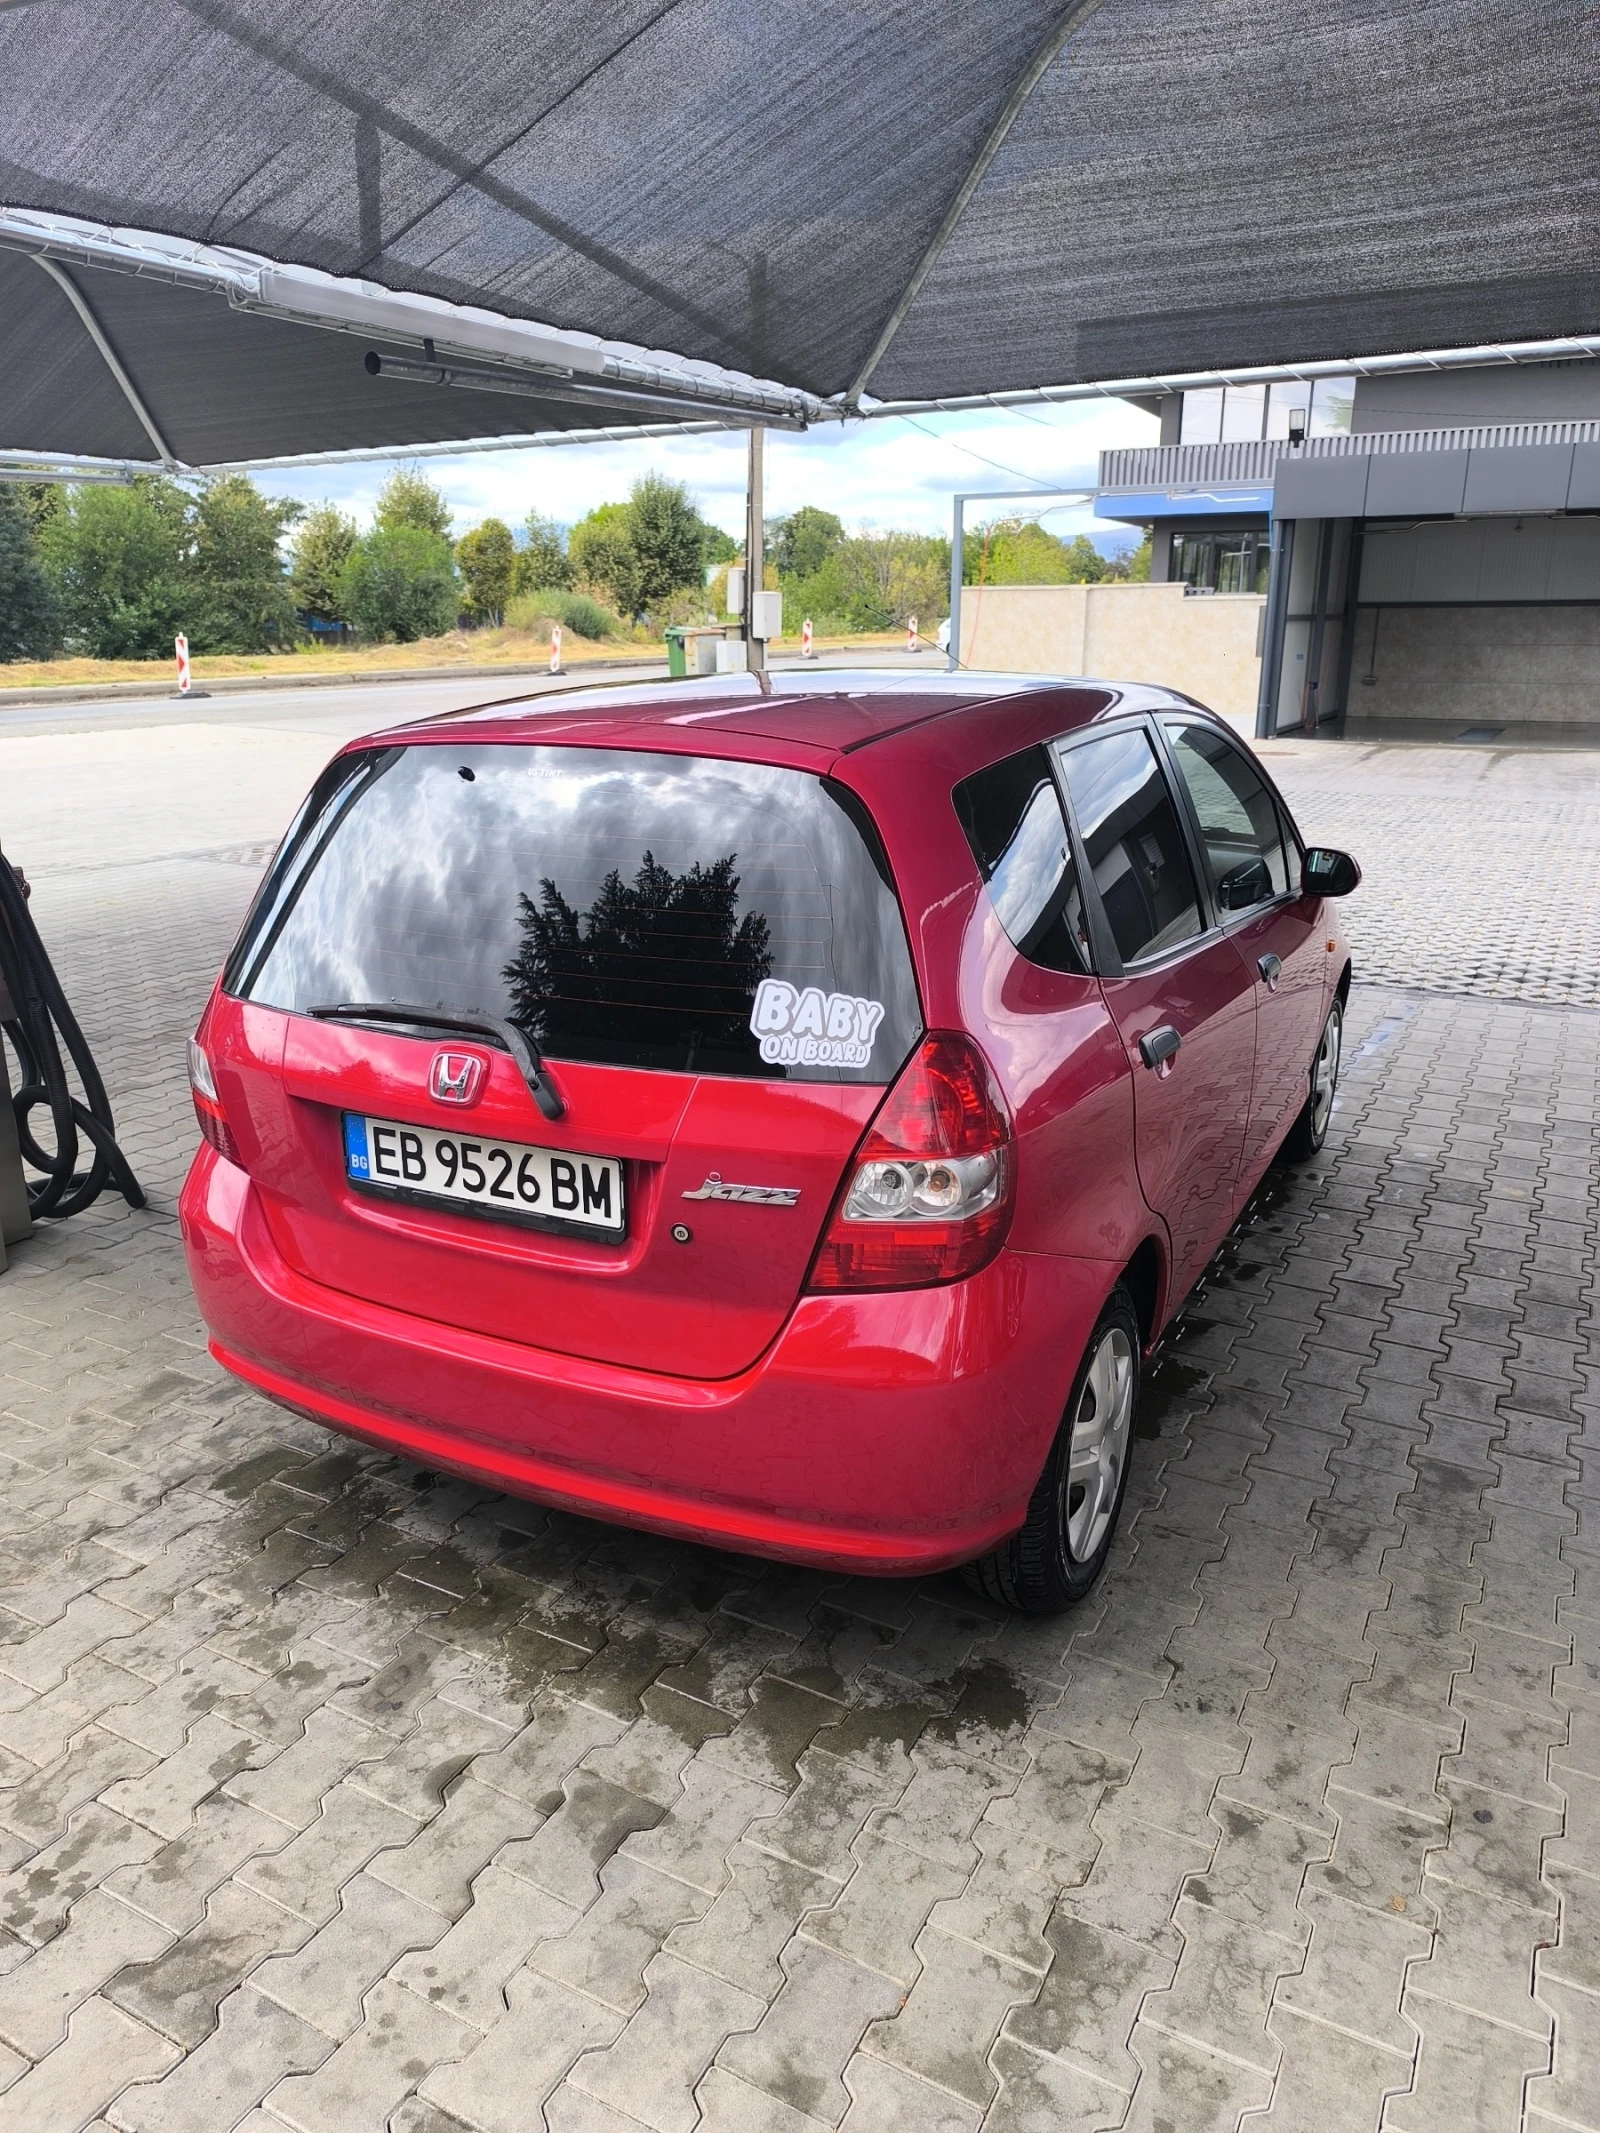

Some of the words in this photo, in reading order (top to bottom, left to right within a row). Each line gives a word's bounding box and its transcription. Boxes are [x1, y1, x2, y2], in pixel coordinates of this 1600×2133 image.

[540, 769, 562, 778] TINT
[755, 983, 881, 1044] BABY
[764, 1035, 800, 1061] ON
[803, 1038, 868, 1064] BOARD
[351, 1153, 368, 1170] BG
[373, 1126, 426, 1182] EB
[435, 1139, 541, 1203] 9526
[550, 1158, 612, 1219] BM
